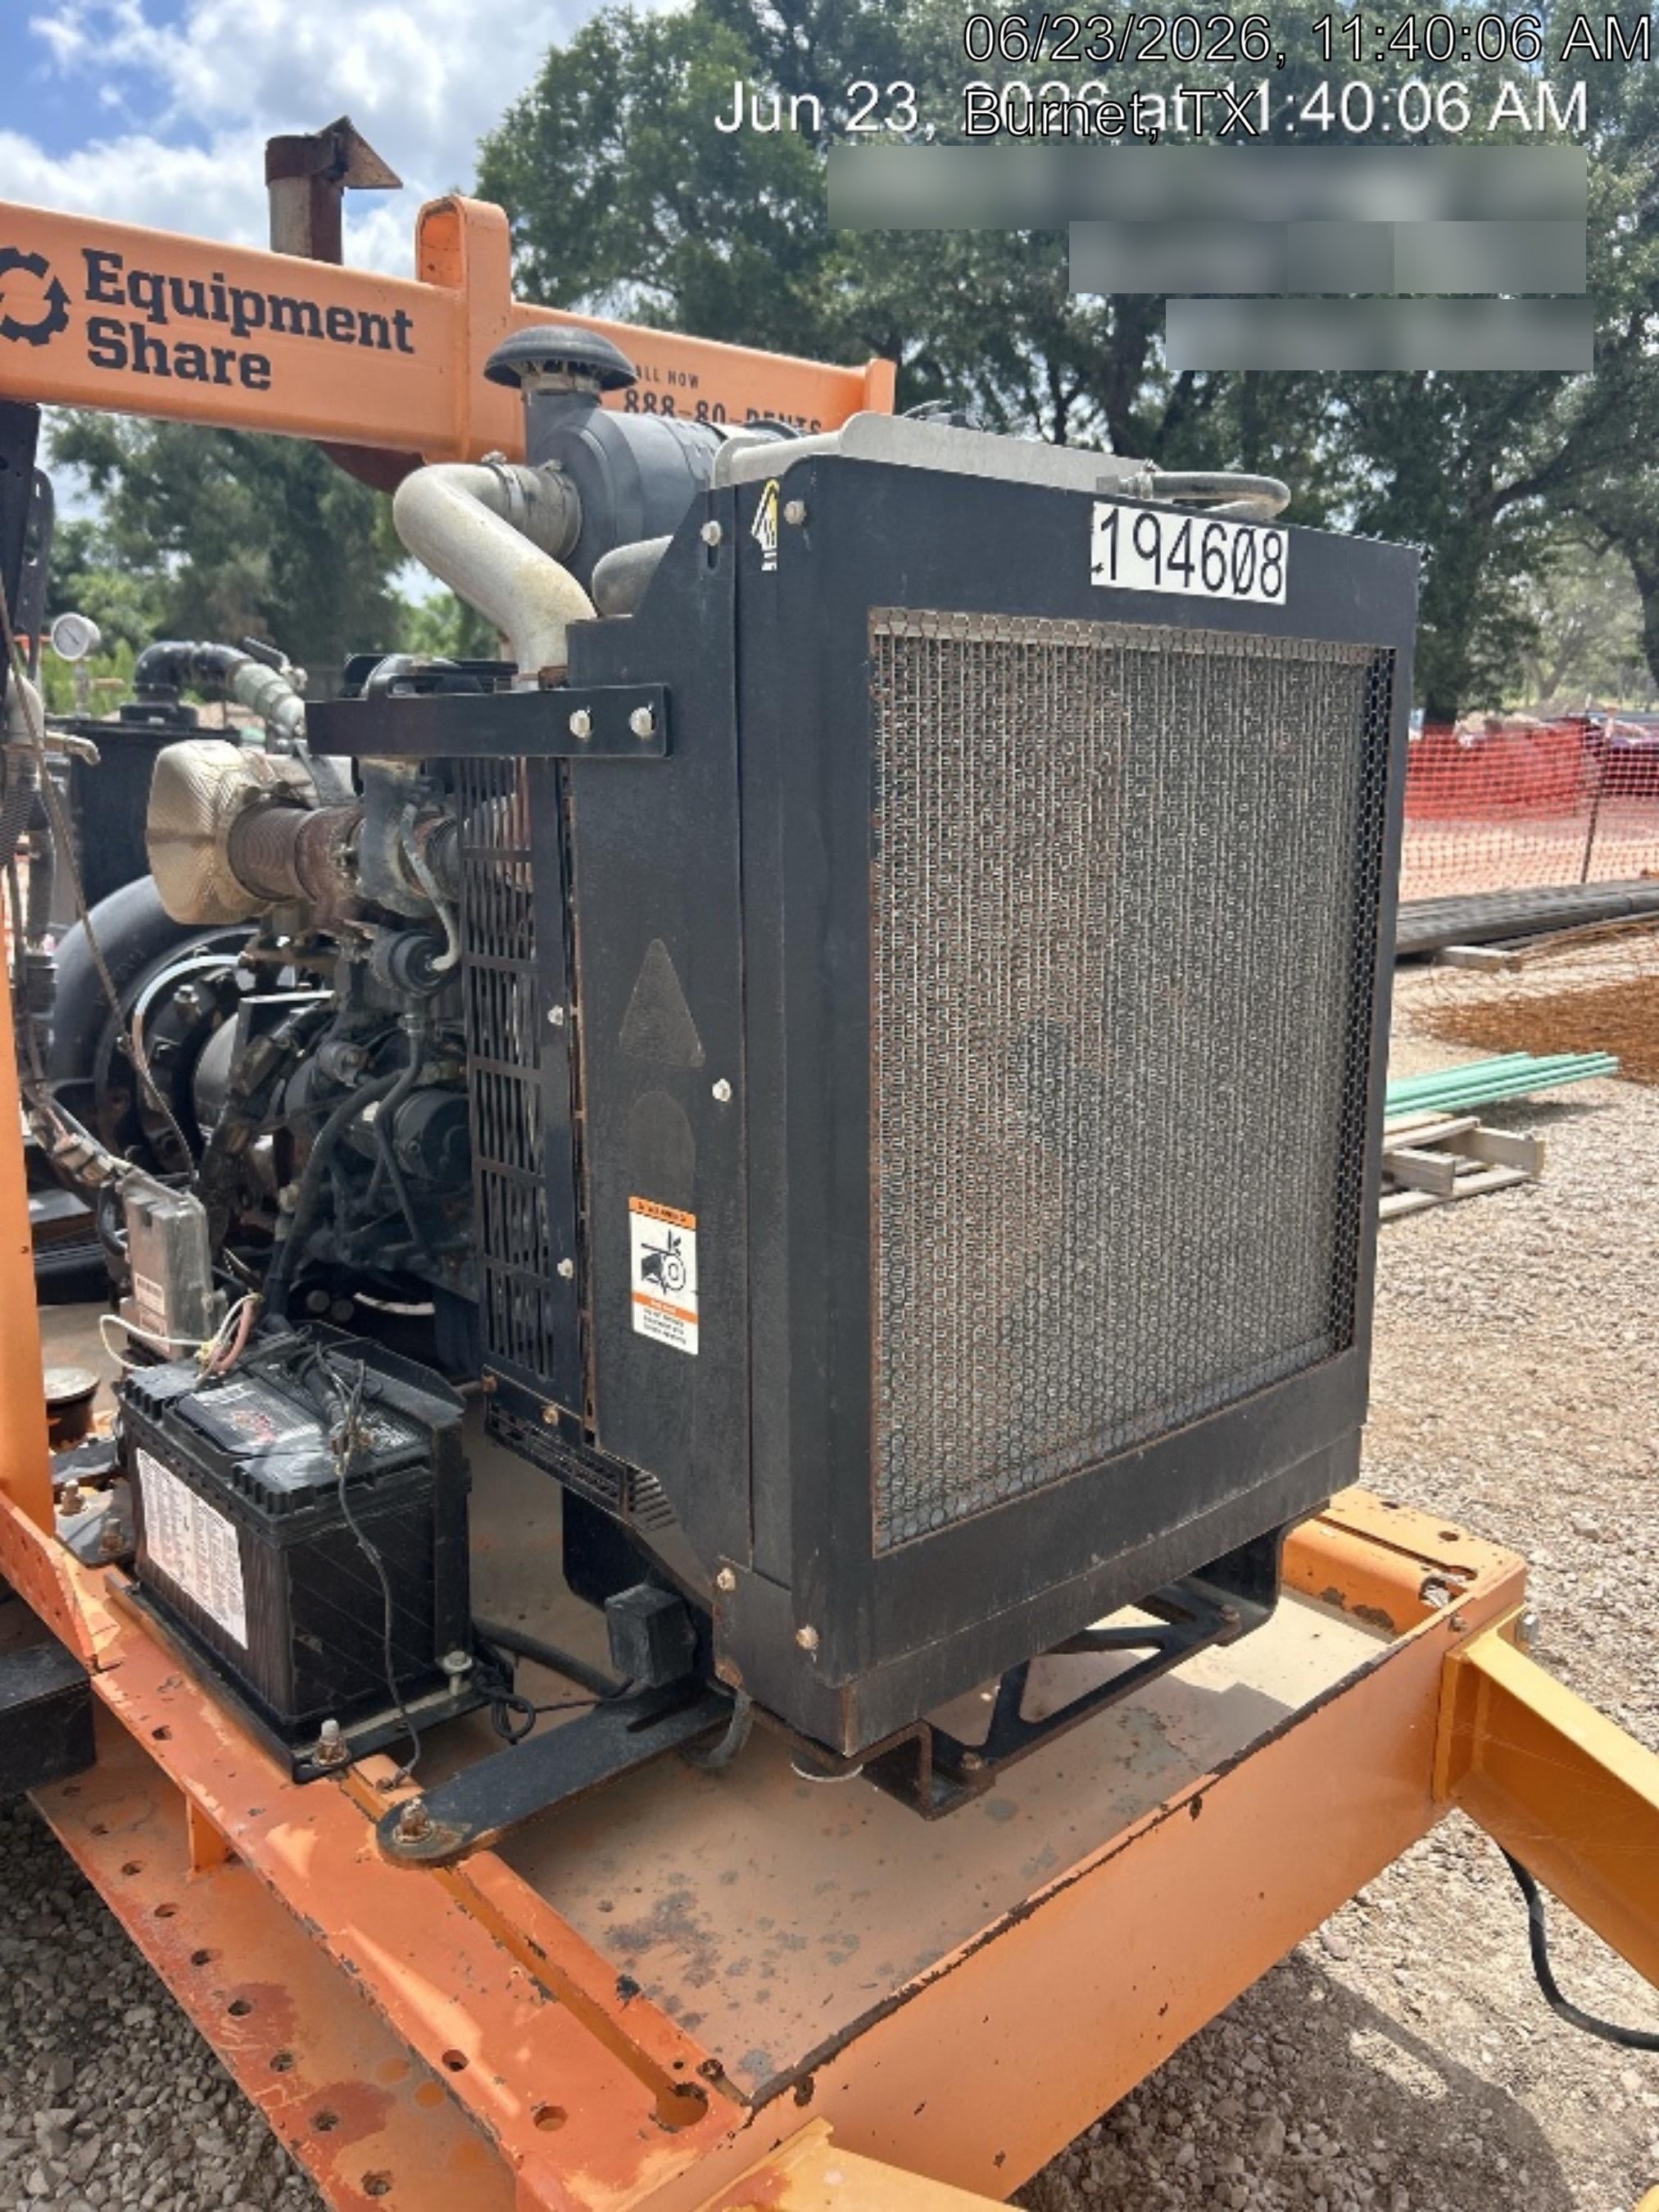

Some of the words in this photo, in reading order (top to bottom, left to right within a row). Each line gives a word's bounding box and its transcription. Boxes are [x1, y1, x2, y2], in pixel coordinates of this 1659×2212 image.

[82, 247, 415, 355] Equipment
[86, 315, 272, 391] Share
[635, 365, 660, 383] ALL
[668, 370, 699, 389] NOW
[1100, 508, 1282, 598] 194608
